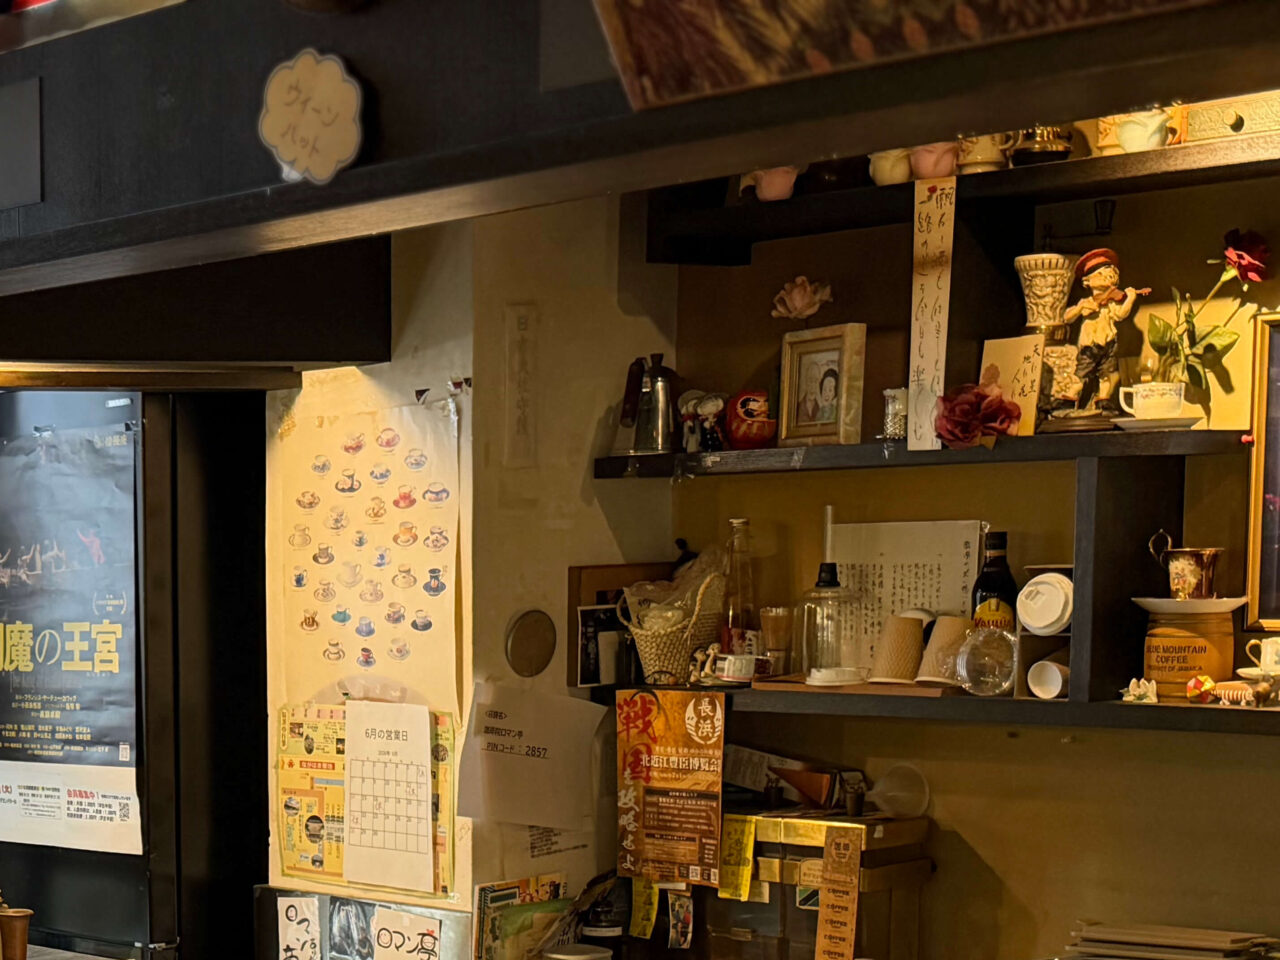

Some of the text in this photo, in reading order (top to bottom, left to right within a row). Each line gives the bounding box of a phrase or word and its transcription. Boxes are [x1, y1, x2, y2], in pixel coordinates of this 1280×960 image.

[1163, 645, 1207, 655] MOUNTAIN
[1155, 655, 1189, 664] COFFEE
[697, 698, 715, 738] 長浜
[365, 728, 408, 742] 6月の営業日
[525, 745, 548, 758] 2857
